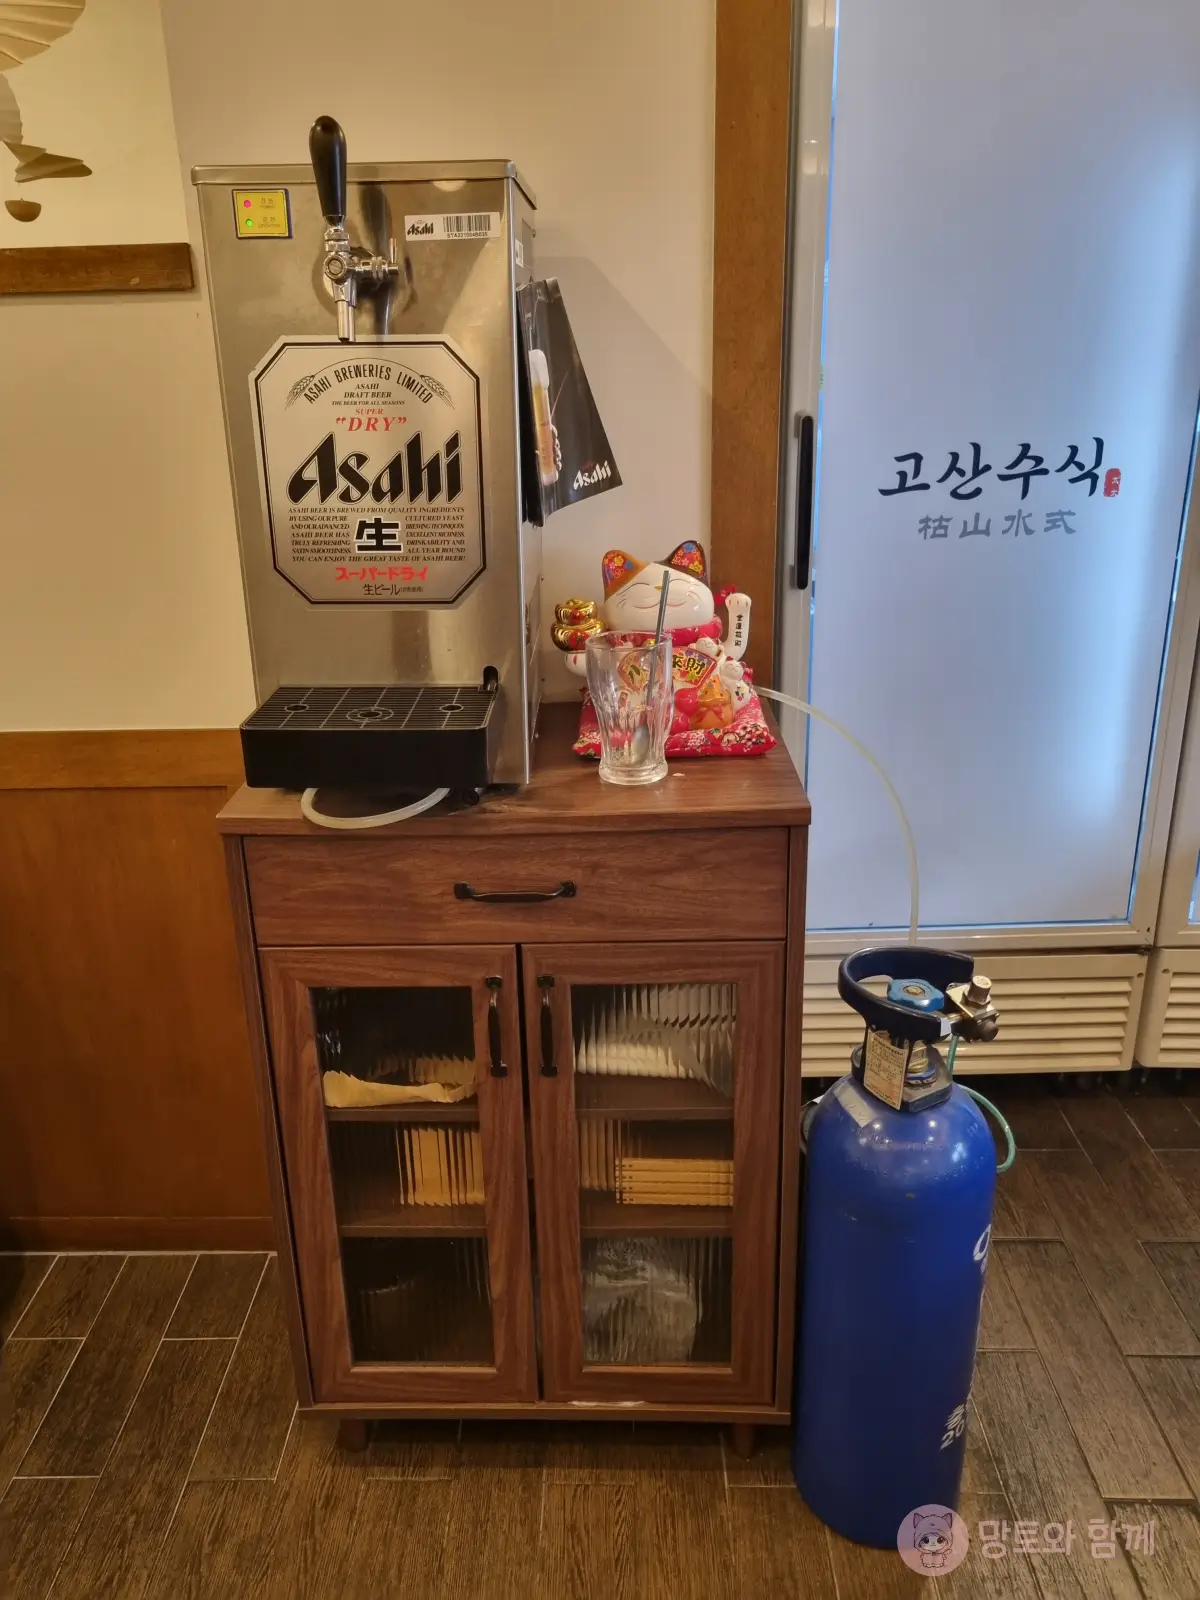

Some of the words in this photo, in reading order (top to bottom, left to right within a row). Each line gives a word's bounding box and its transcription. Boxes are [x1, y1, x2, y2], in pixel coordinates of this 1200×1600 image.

[407, 222, 434, 236] Asahi
[304, 376, 332, 404] ASAHI
[334, 364, 392, 383] BREWERIES
[397, 371, 434, 404] LIMITED
[286, 430, 463, 505] Asahi
[573, 460, 612, 490] Asahi
[878, 437, 1105, 500] 고산수식
[355, 516, 403, 553] 生
[918, 509, 1077, 540] 枯山水式
[335, 566, 428, 582] スーパードライ
[363, 584, 400, 596] 生ビール
